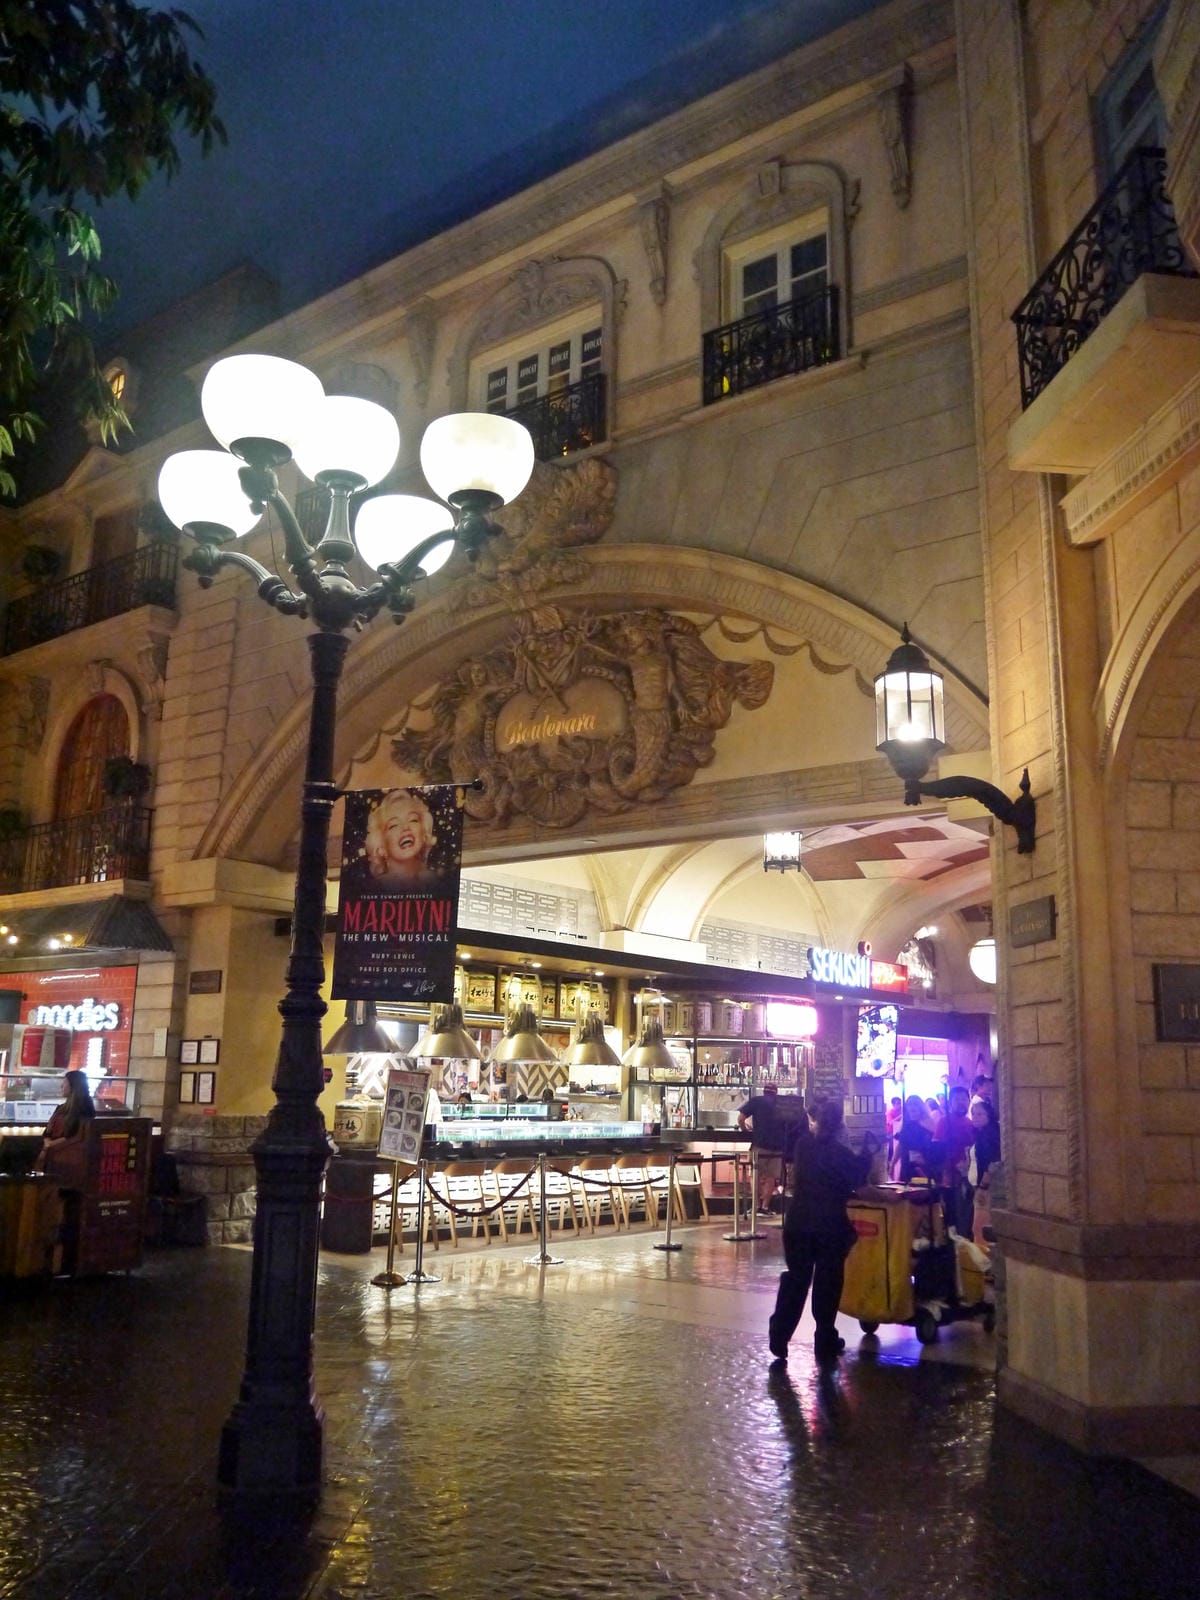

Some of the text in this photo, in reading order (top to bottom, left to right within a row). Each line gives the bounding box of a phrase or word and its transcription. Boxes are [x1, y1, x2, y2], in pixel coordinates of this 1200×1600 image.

[342, 899, 452, 937] MARILYN!
[342, 933, 449, 942] THE NEW MUSICAL
[811, 946, 871, 990] SEKUSHI
[36, 997, 119, 1032] noodles
